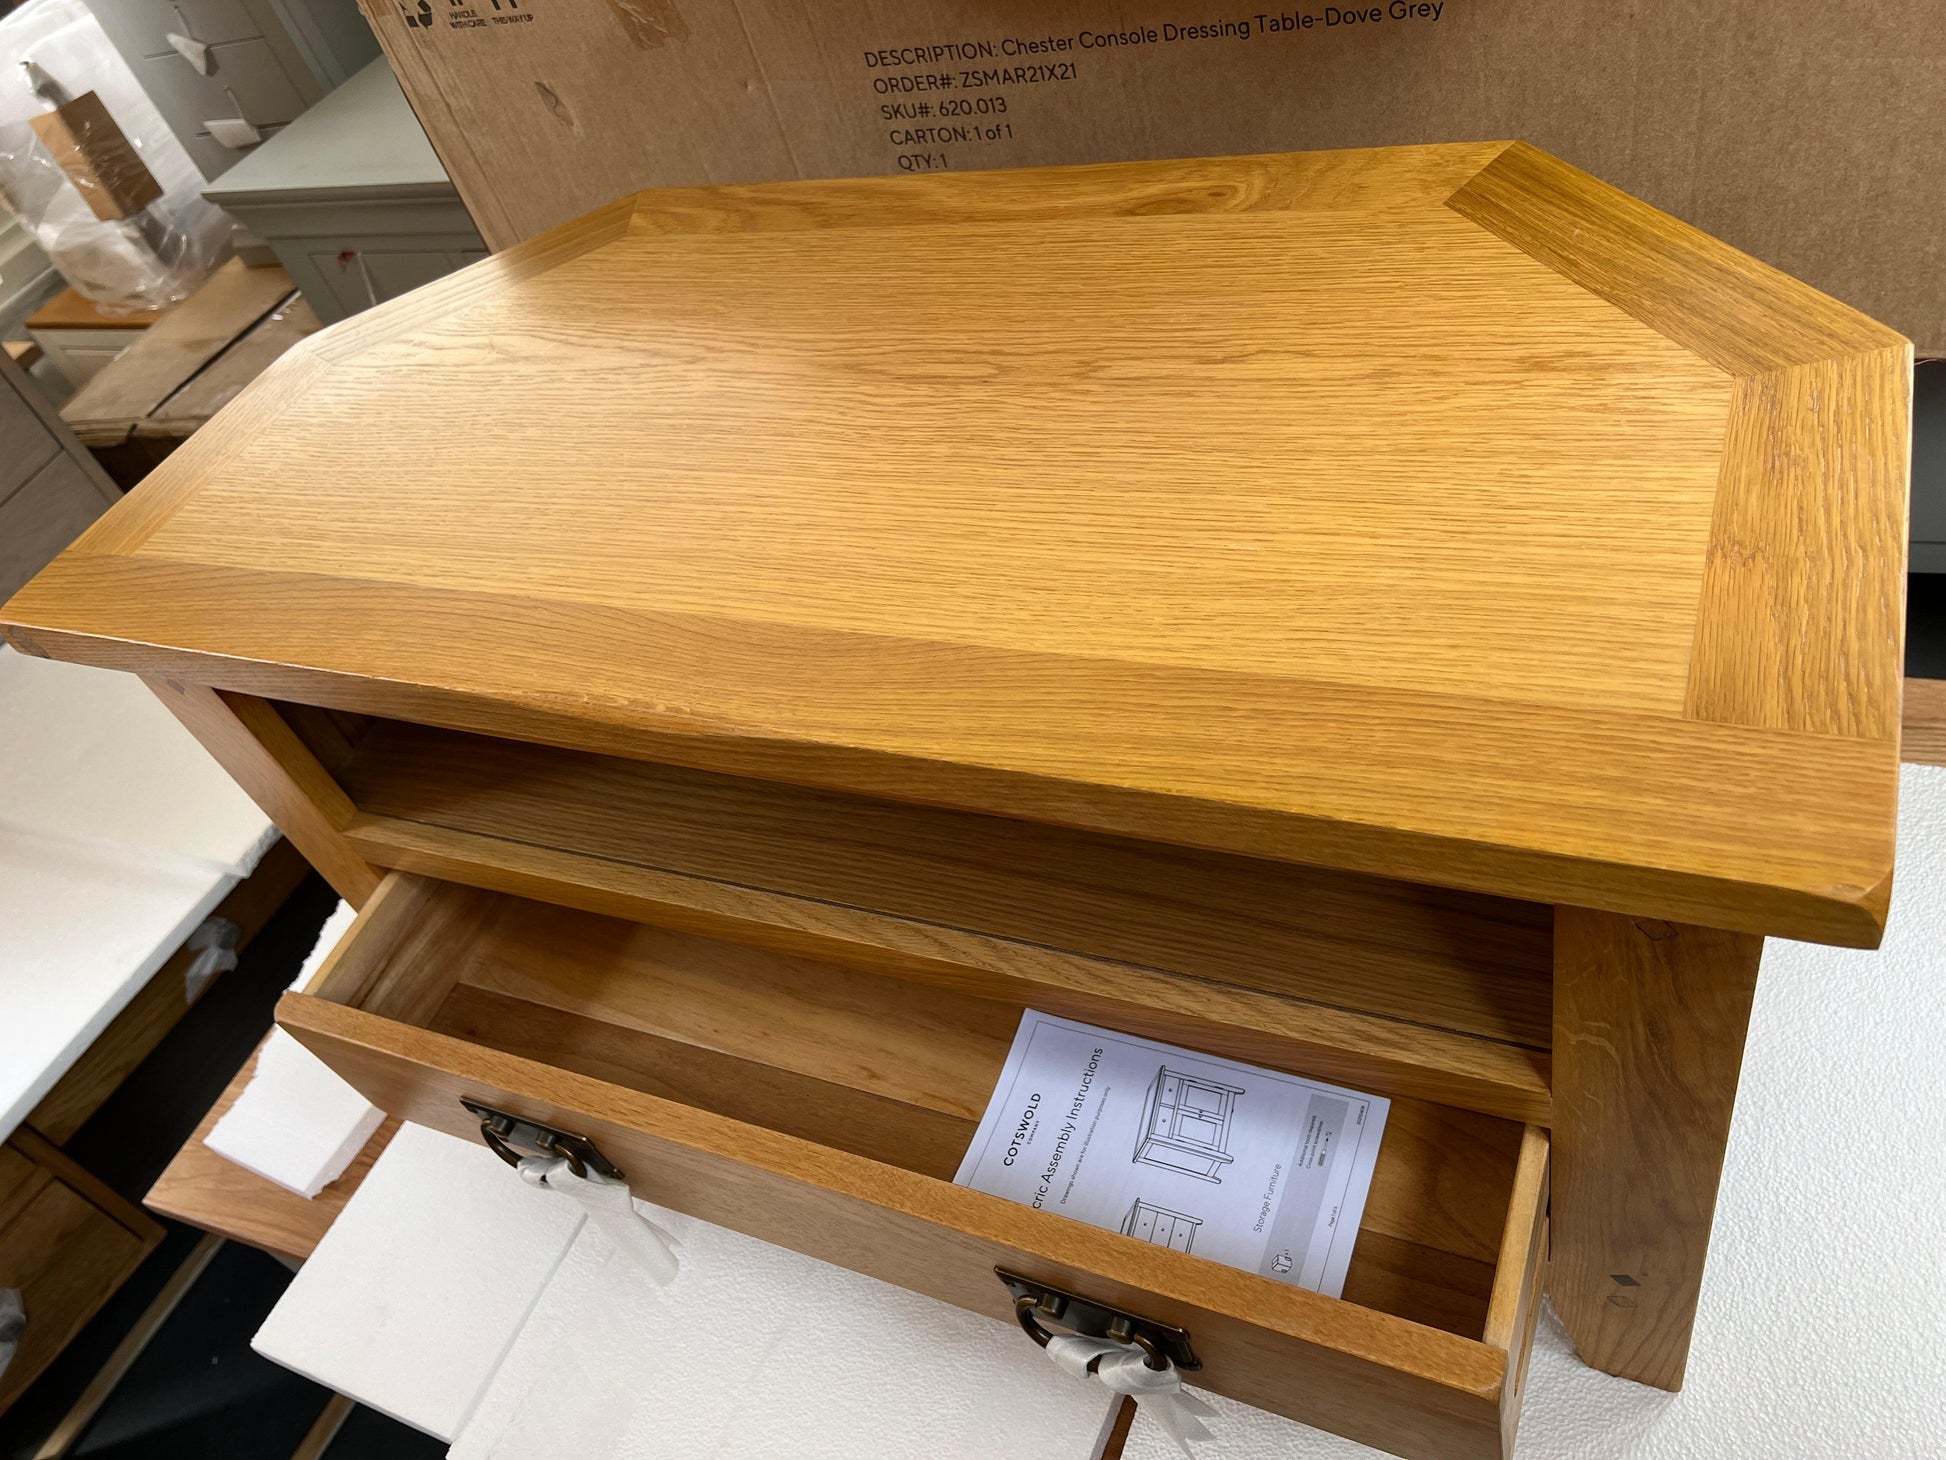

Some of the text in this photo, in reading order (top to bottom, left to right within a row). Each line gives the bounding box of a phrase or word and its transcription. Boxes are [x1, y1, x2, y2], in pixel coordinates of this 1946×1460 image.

[864, 0, 1444, 68] DESCRIPTION: Chester Console Dressing Table-Dove Grey
[873, 63, 1078, 95] ORDER#: ZSMAR21X21
[881, 97, 1008, 120] SKU#: 620.013
[890, 123, 1013, 146] CARTON: 1 of 1
[898, 153, 948, 171] QTY: 1
[1003, 1093, 1041, 1166] COTSWOLD
[1027, 1120, 1040, 1145] COMPANY
[1041, 1121, 1076, 1184] Assembly
[1066, 1047, 1103, 1120] Instructions
[1060, 1181, 1074, 1205] Drawings
[1071, 1163, 1080, 1180] shown
[1253, 1163, 1282, 1233] Storage Furniture
